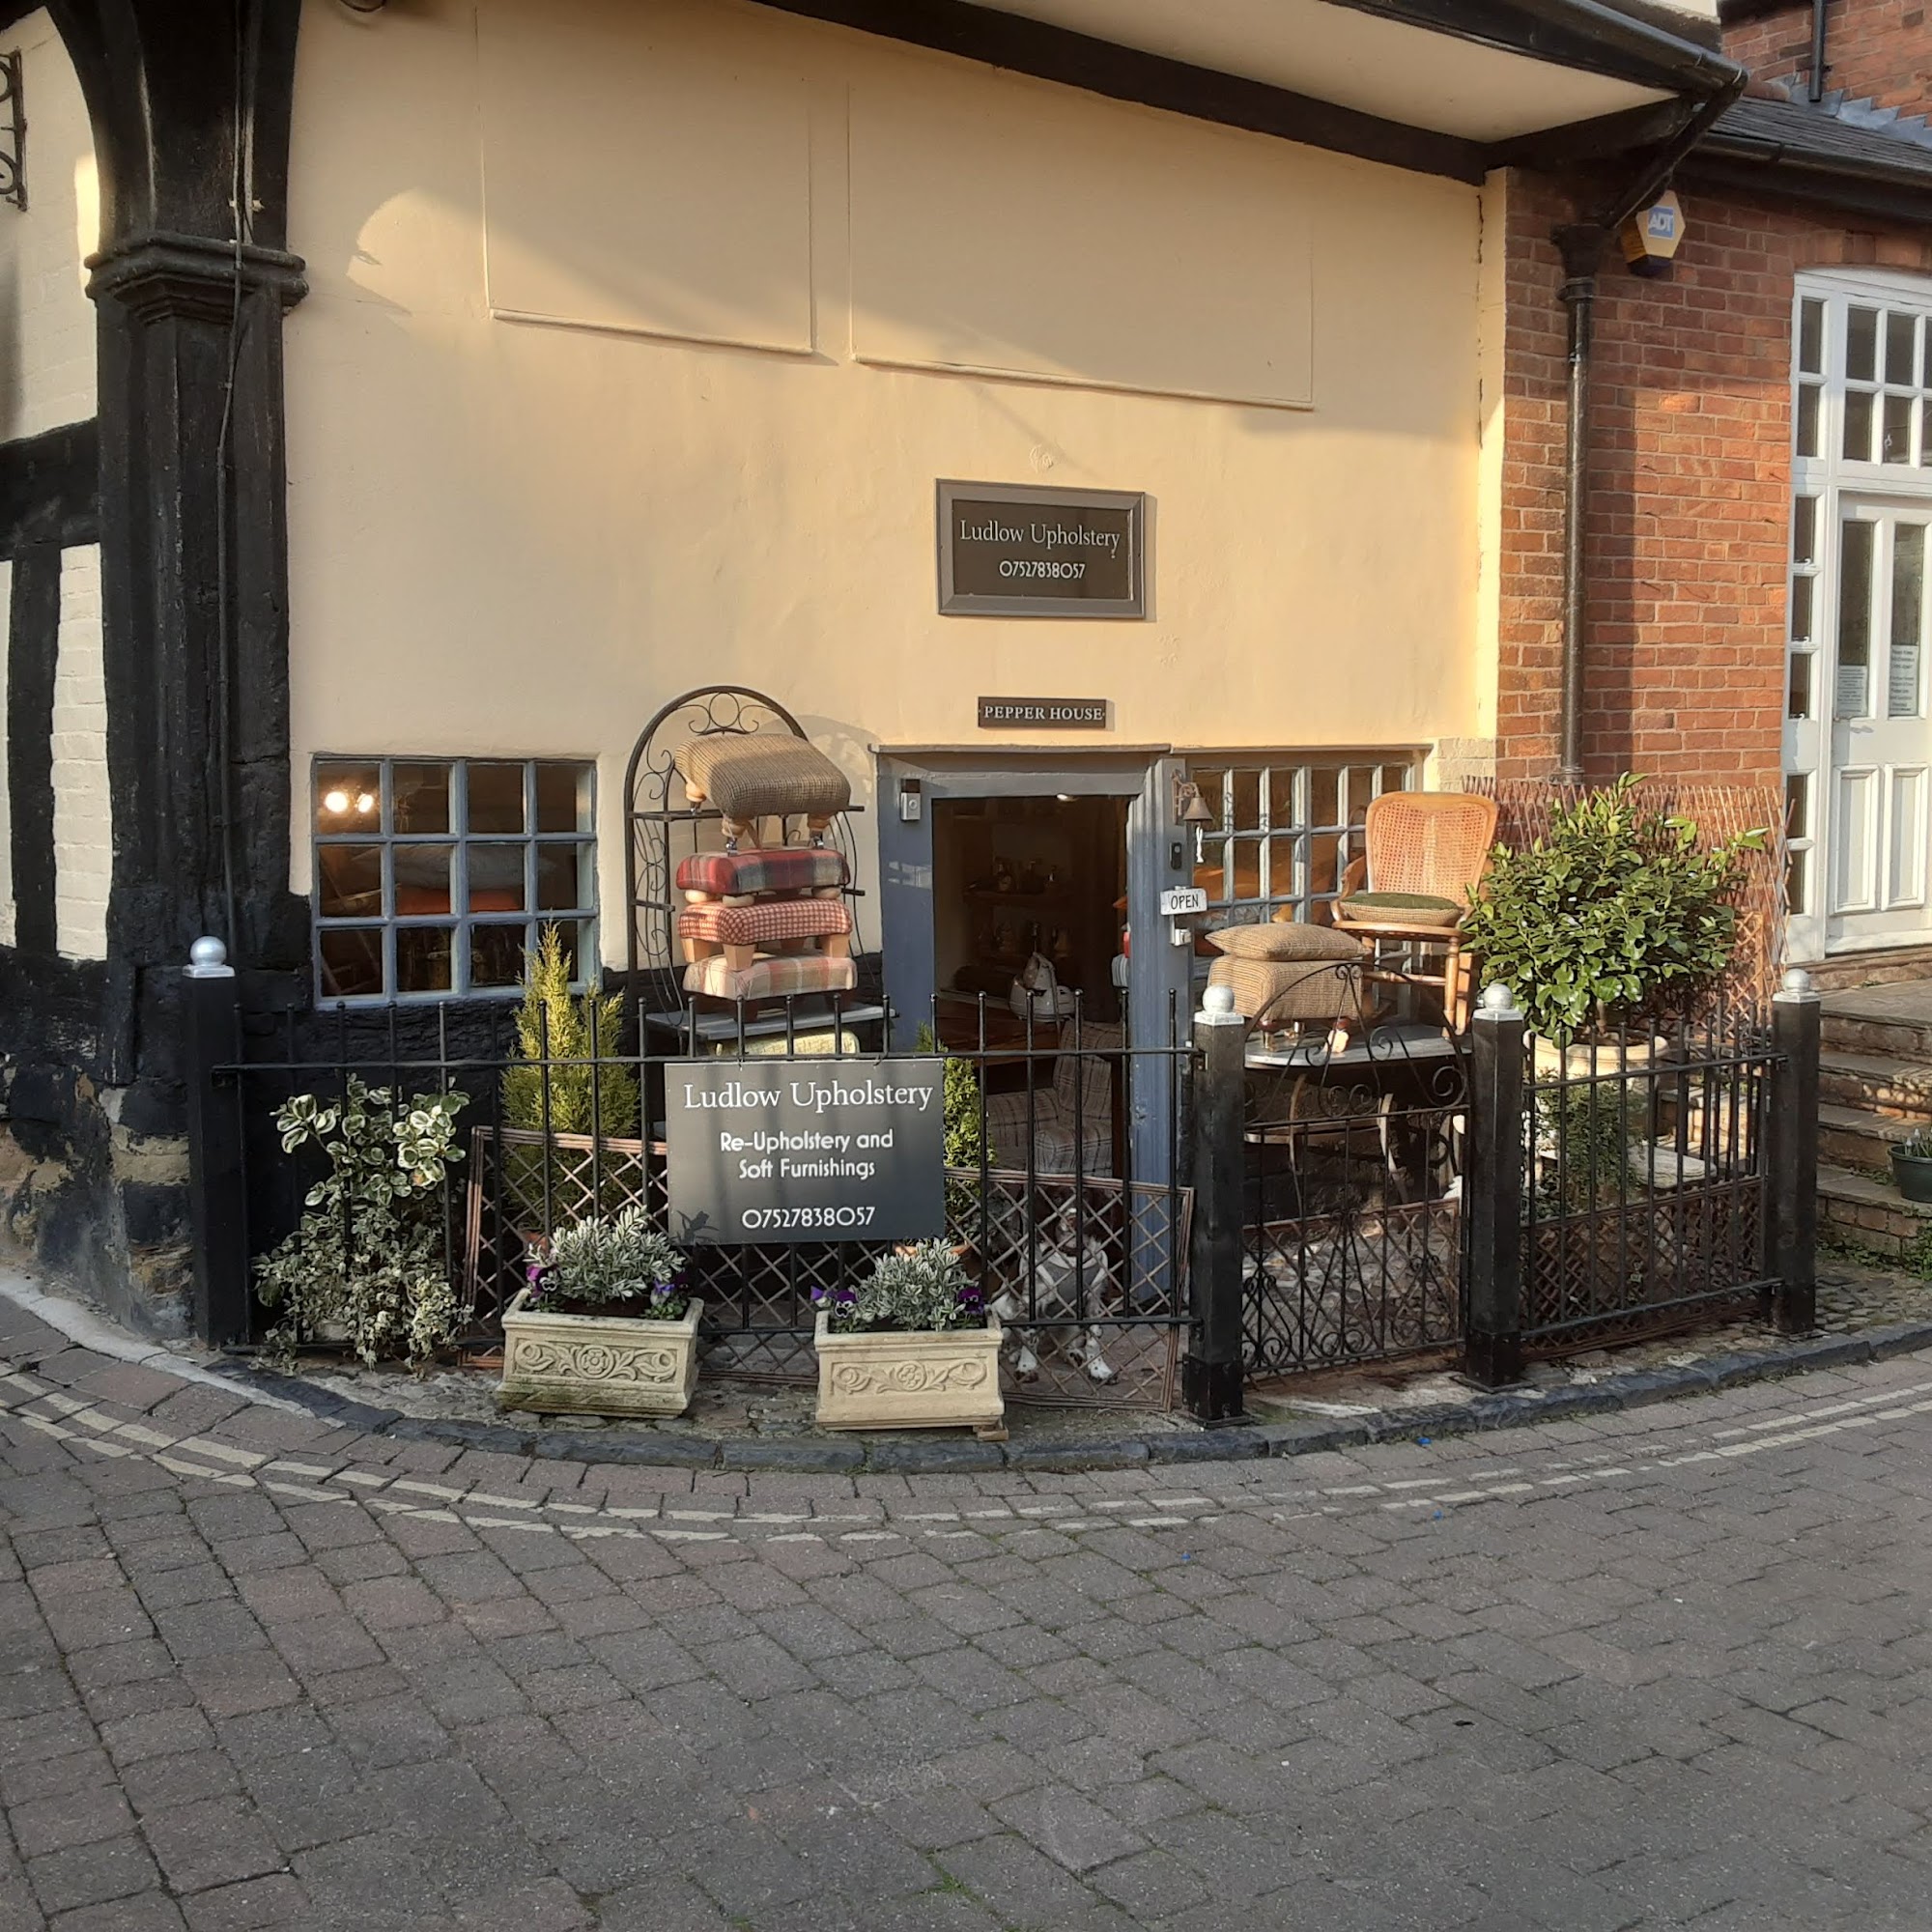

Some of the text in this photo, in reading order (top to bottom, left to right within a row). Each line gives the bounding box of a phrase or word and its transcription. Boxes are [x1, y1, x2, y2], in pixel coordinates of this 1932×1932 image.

[1648, 212, 1673, 232] ADT
[959, 520, 1121, 551] Ludlow Upholstery
[999, 560, 1085, 579] 07527838057
[984, 706, 1103, 721] PEPPER HOUSE
[1171, 894, 1199, 910] OPEN
[684, 1079, 932, 1113] Ludlow Upholstery
[720, 1128, 894, 1154] Re-Upholstery and
[738, 1157, 875, 1180] Soft Furnishings
[741, 1206, 876, 1230] 07527838057
